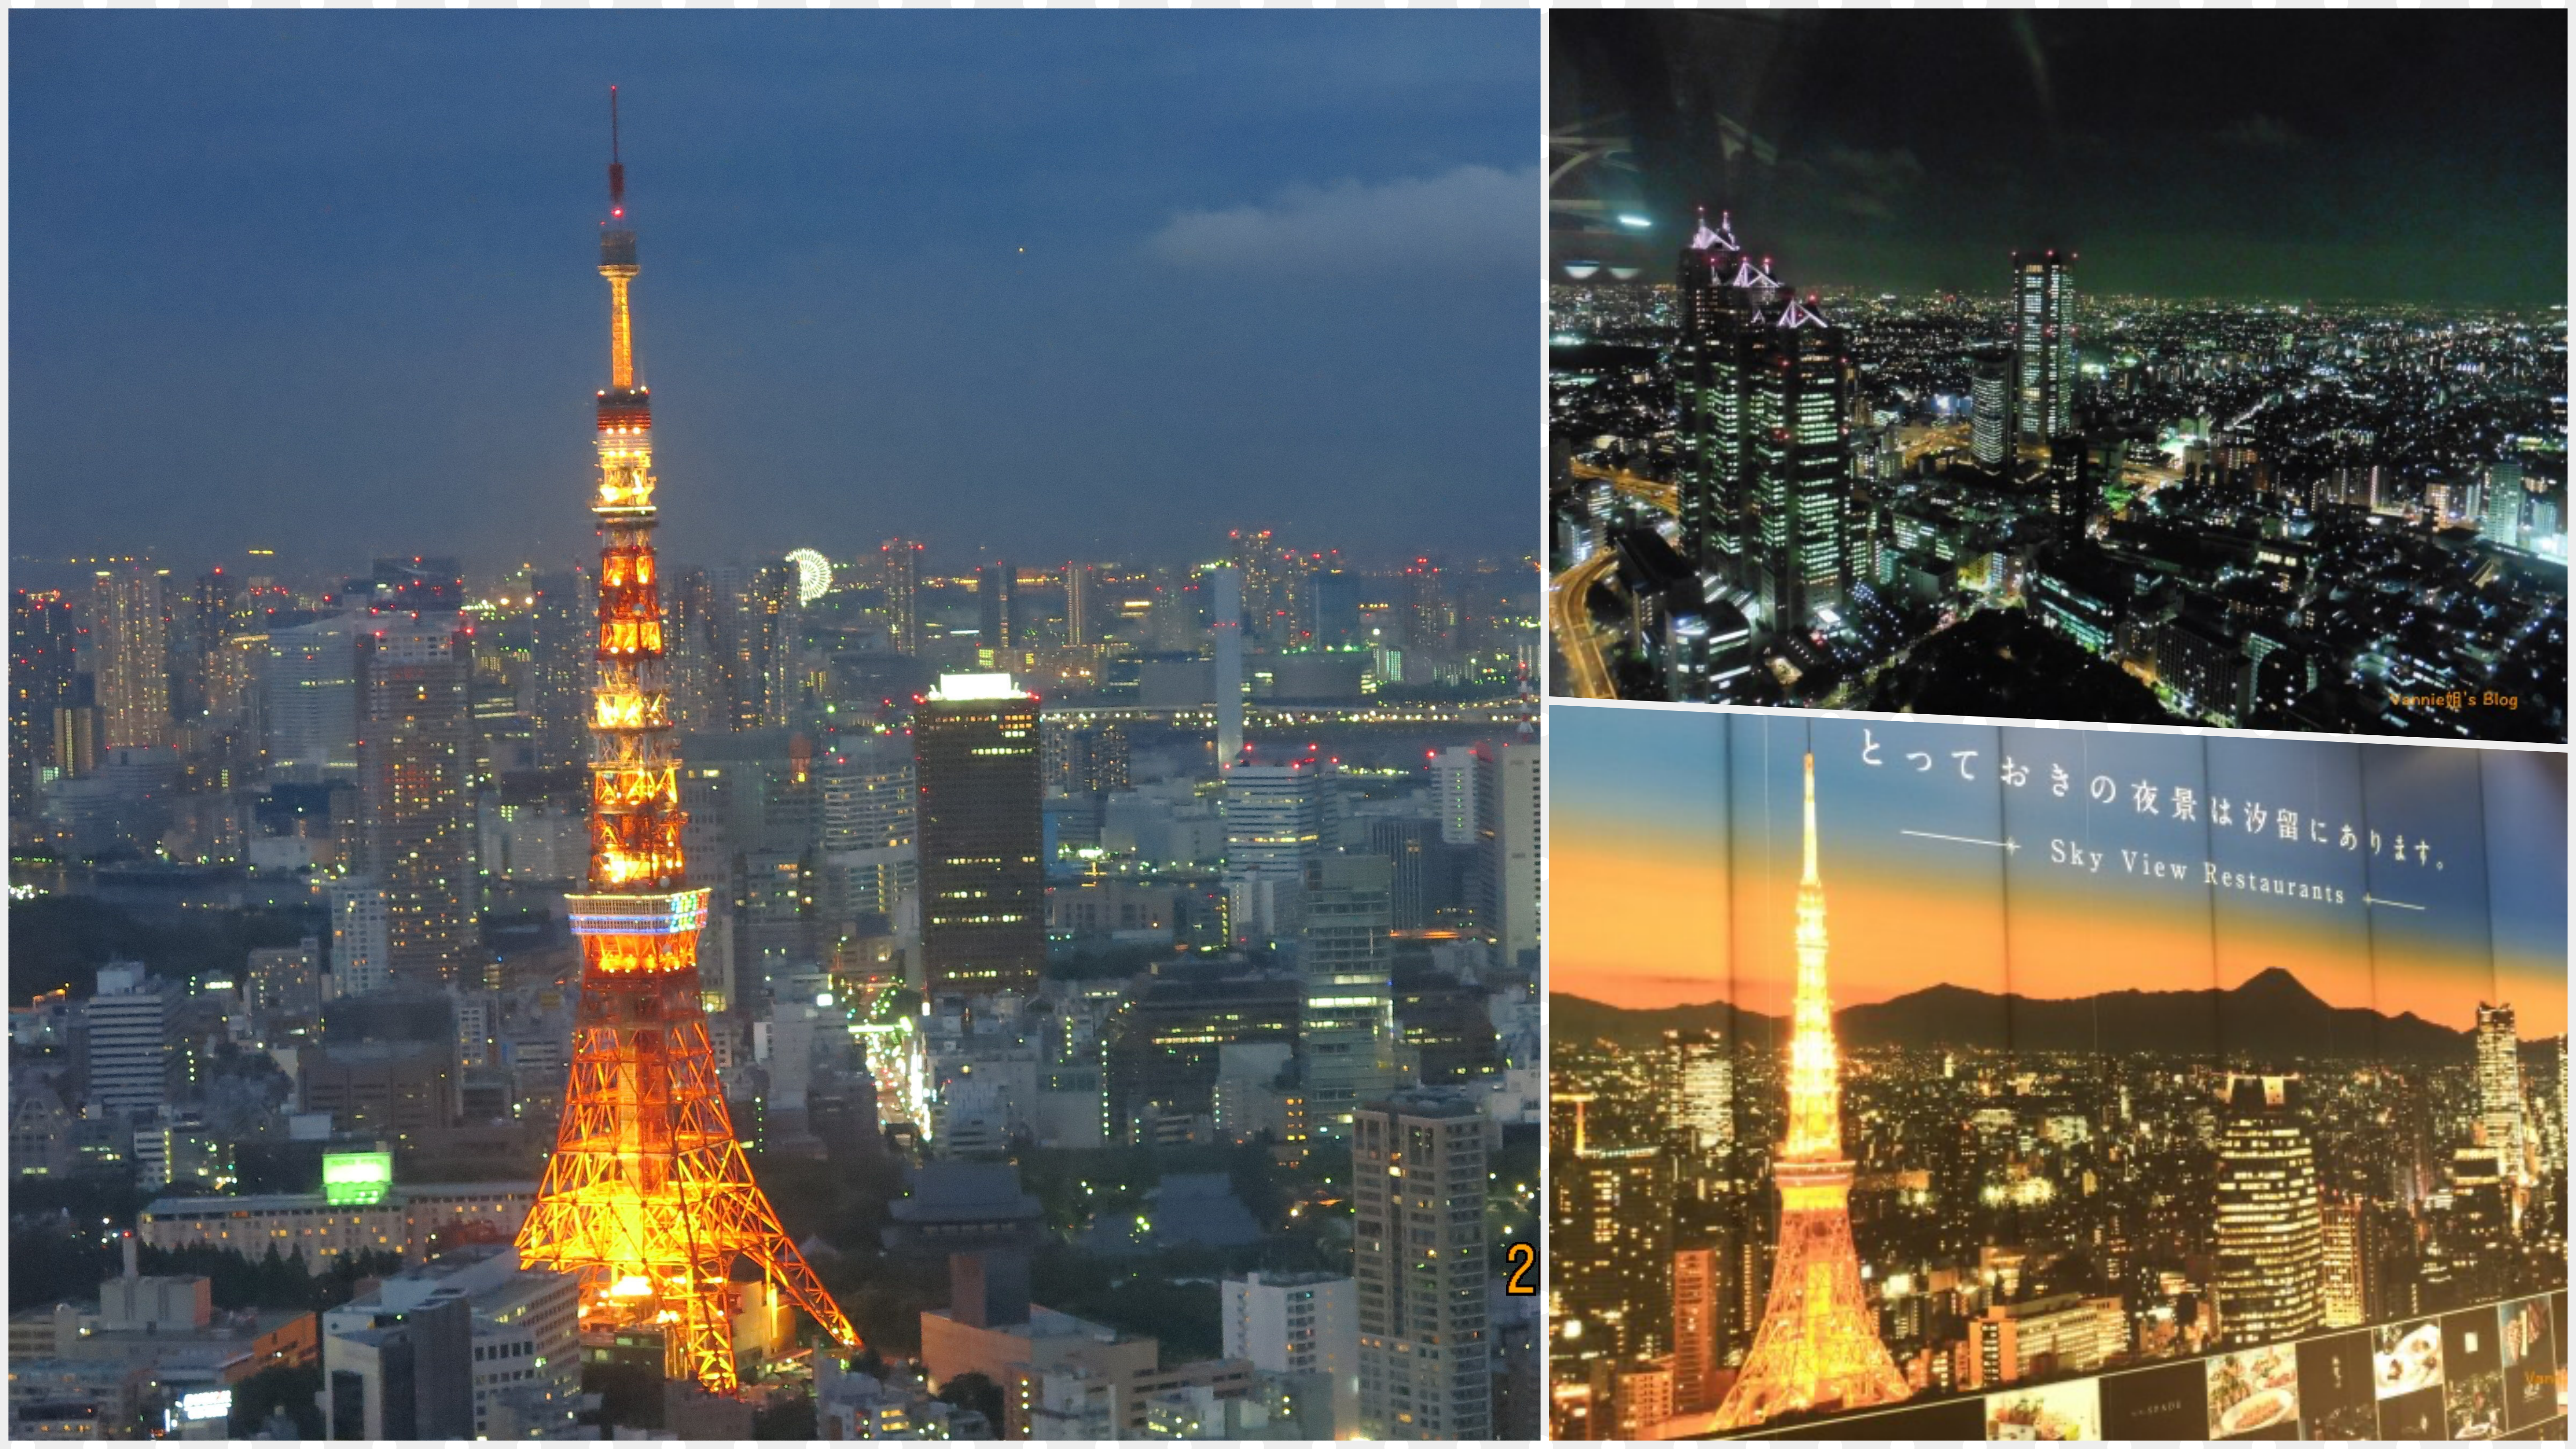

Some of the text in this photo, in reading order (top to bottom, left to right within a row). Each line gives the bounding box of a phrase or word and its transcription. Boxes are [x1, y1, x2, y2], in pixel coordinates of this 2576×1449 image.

[1861, 728, 2444, 870] とっておきの夜景は汐留にあります。
[2051, 839, 2345, 904] Sky View Restaurants
